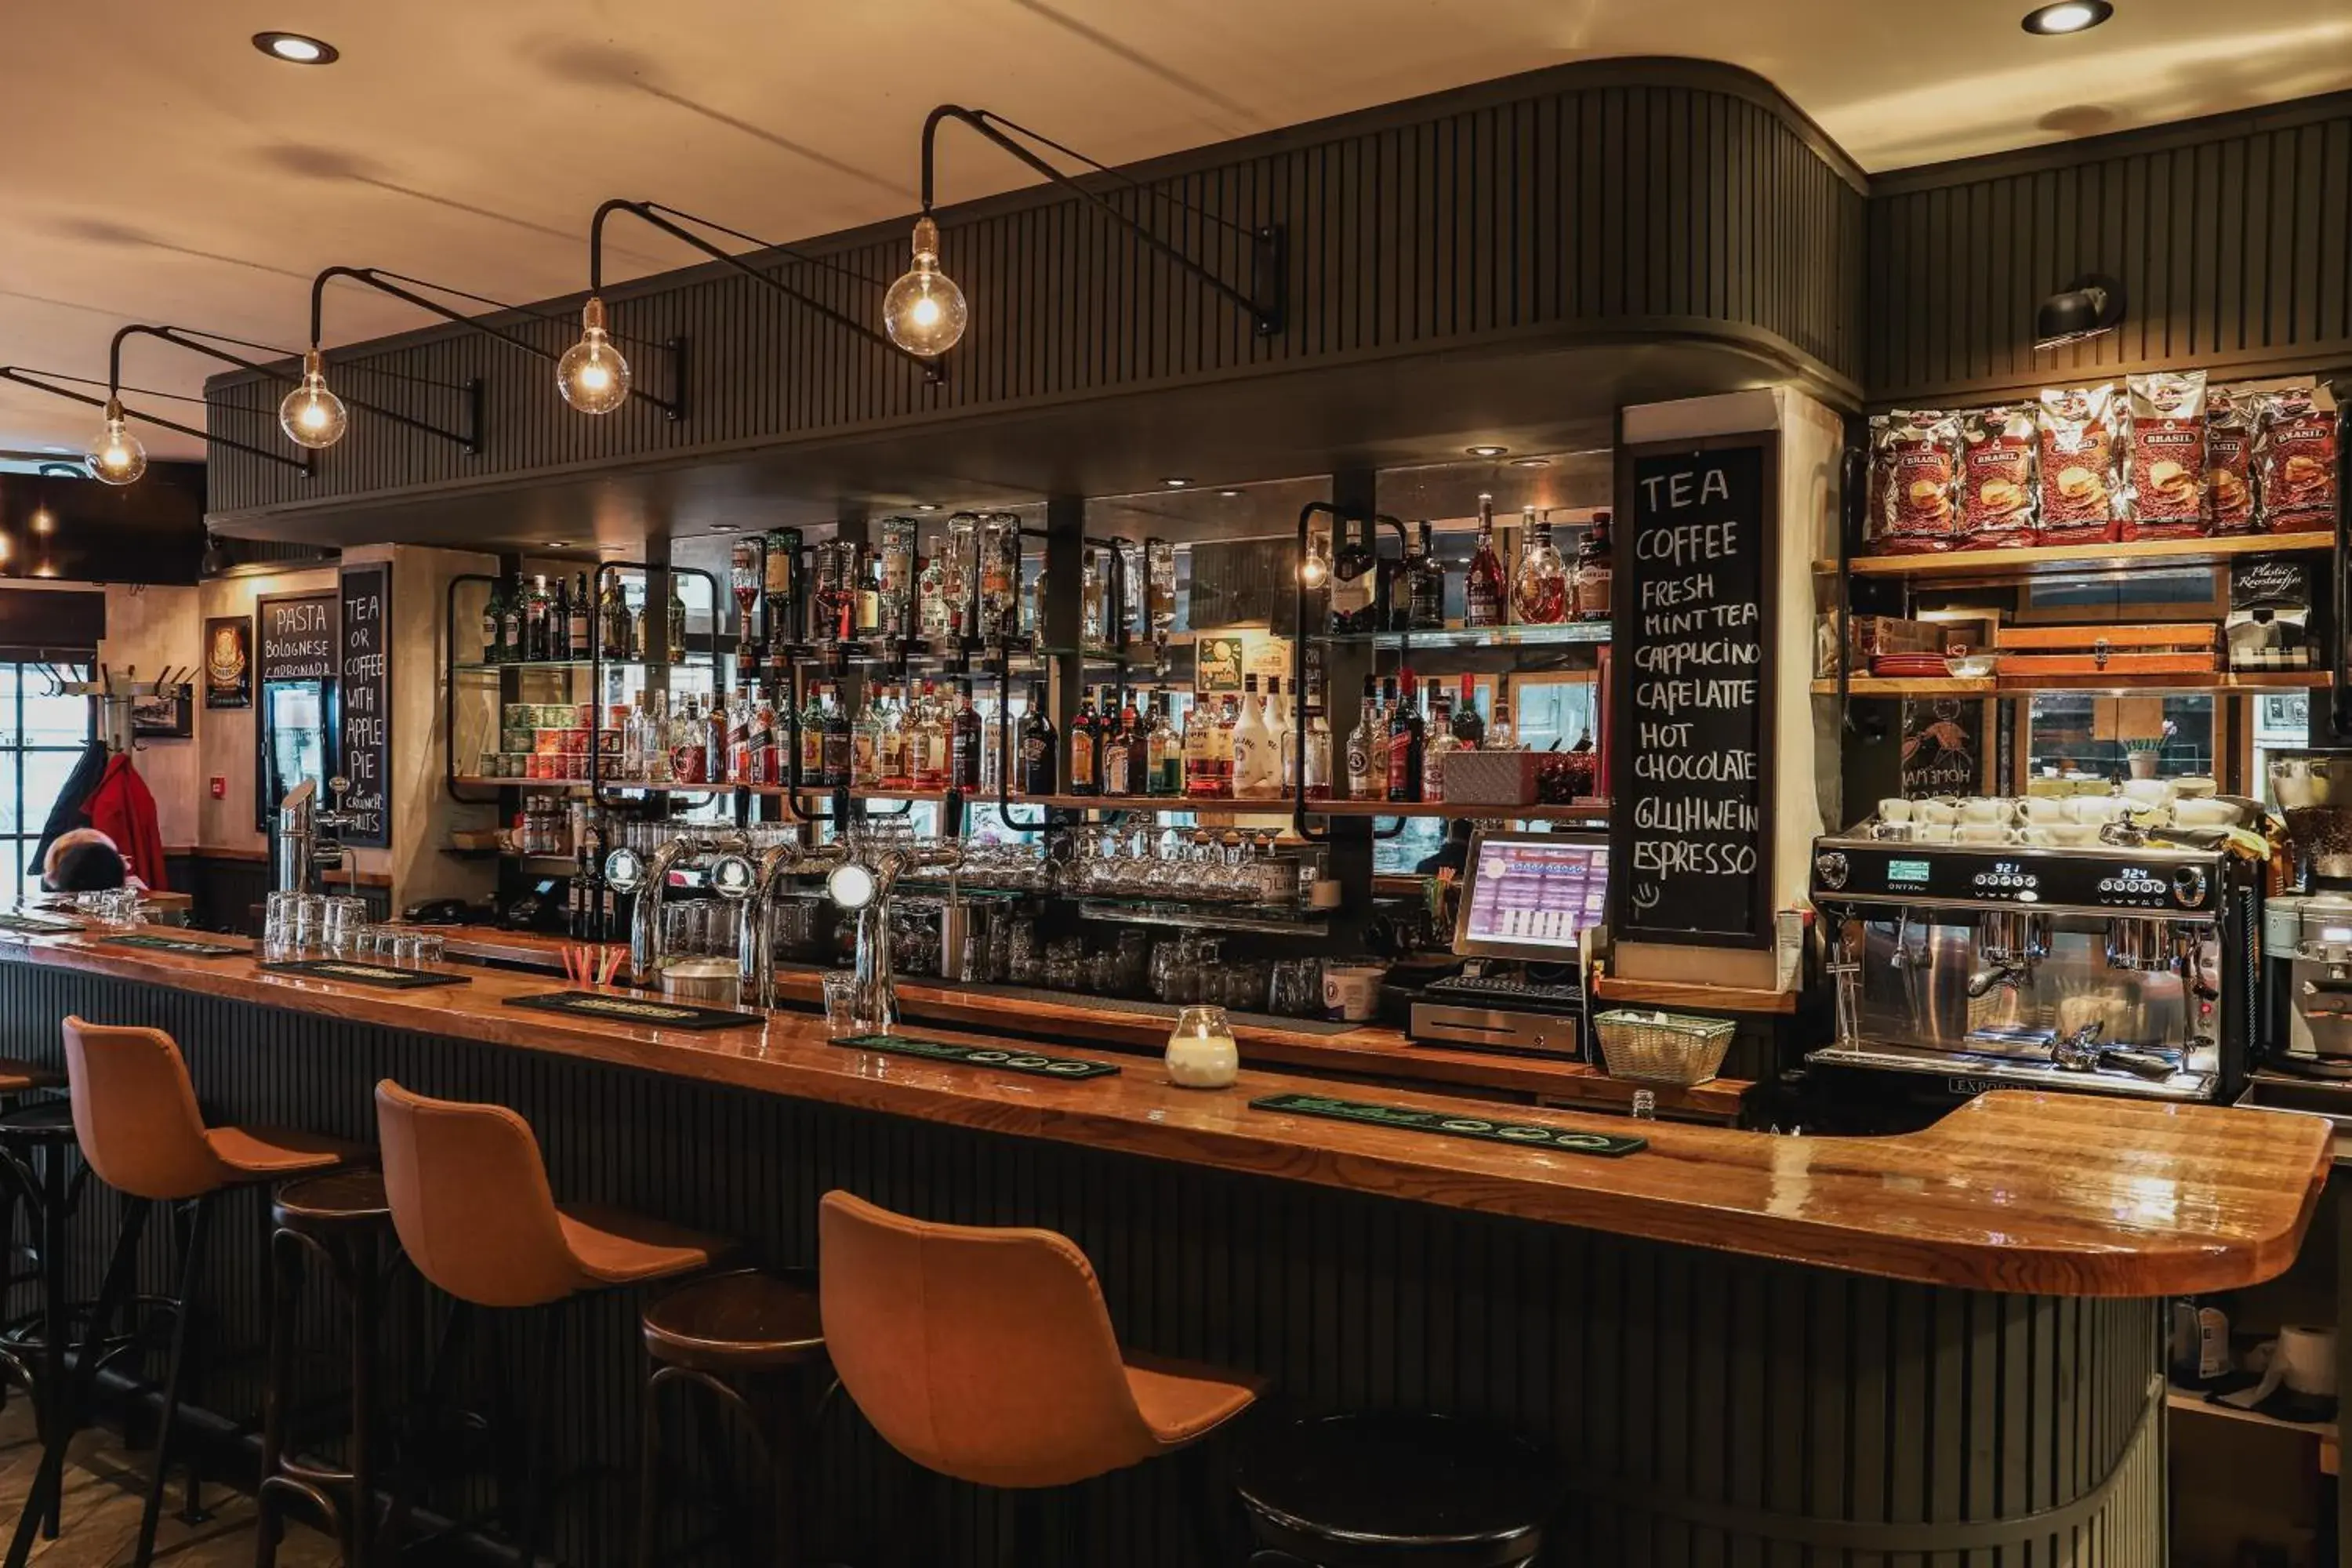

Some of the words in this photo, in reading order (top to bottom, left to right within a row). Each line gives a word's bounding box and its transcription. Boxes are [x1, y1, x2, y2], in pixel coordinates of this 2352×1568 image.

[2146, 434, 2194, 444] BRASIL
[1977, 452, 2018, 463] BRASIL
[1640, 469, 1729, 512] TEA
[1636, 521, 1737, 567] COFFEE
[1642, 573, 1715, 611] FRESH
[277, 604, 327, 636] PASTA
[346, 595, 379, 623] TEA
[1710, 603, 1759, 627] TEA
[350, 628, 370, 648] OR
[344, 654, 383, 684] COFFEE
[346, 686, 374, 713] WITH
[346, 717, 383, 747] APPLE
[1640, 721, 1693, 749] HOT
[1635, 749, 1757, 782] CHOCOLATE
[1633, 840, 1757, 880] ESPRESSO
